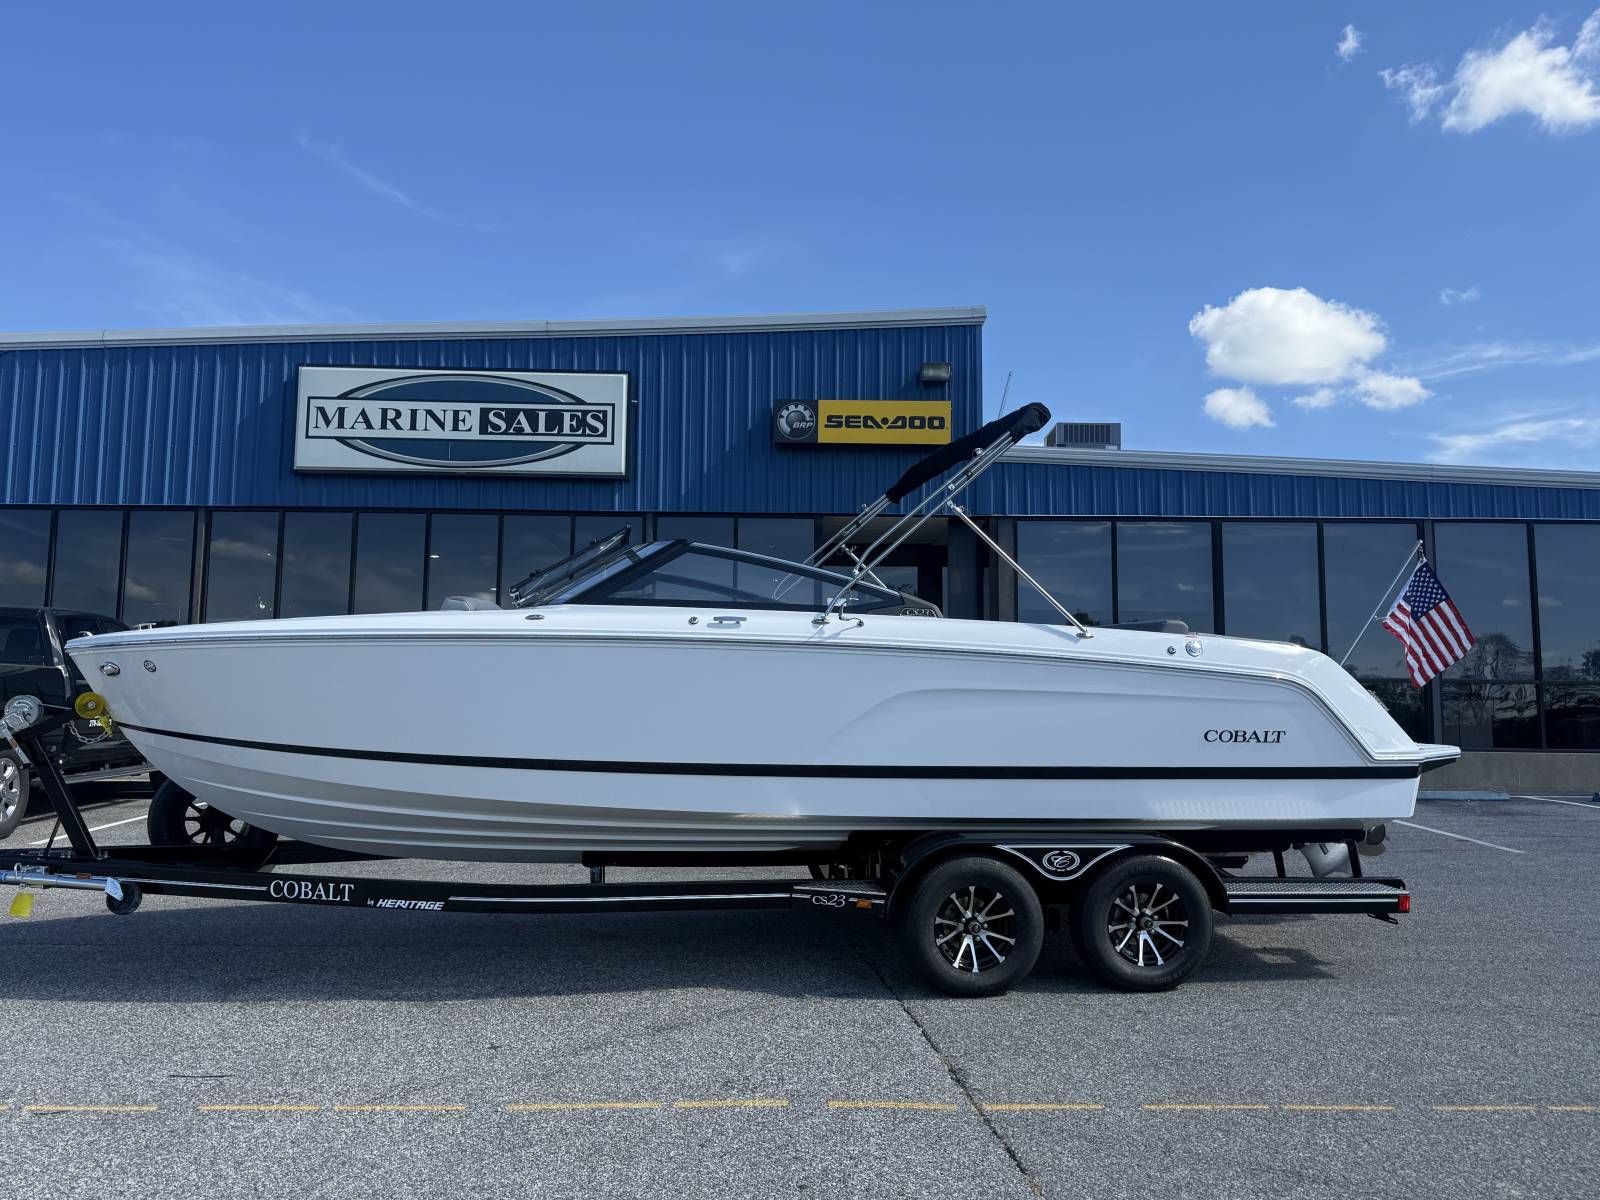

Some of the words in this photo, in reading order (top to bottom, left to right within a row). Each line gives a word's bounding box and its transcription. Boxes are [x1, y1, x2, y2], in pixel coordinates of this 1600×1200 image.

[313, 406, 473, 433] MARINE
[487, 410, 604, 435] SALES
[793, 421, 813, 429] BRP
[1203, 729, 1287, 743] COBALT
[269, 879, 354, 902] COBALT
[376, 899, 445, 911] HERITAGE
